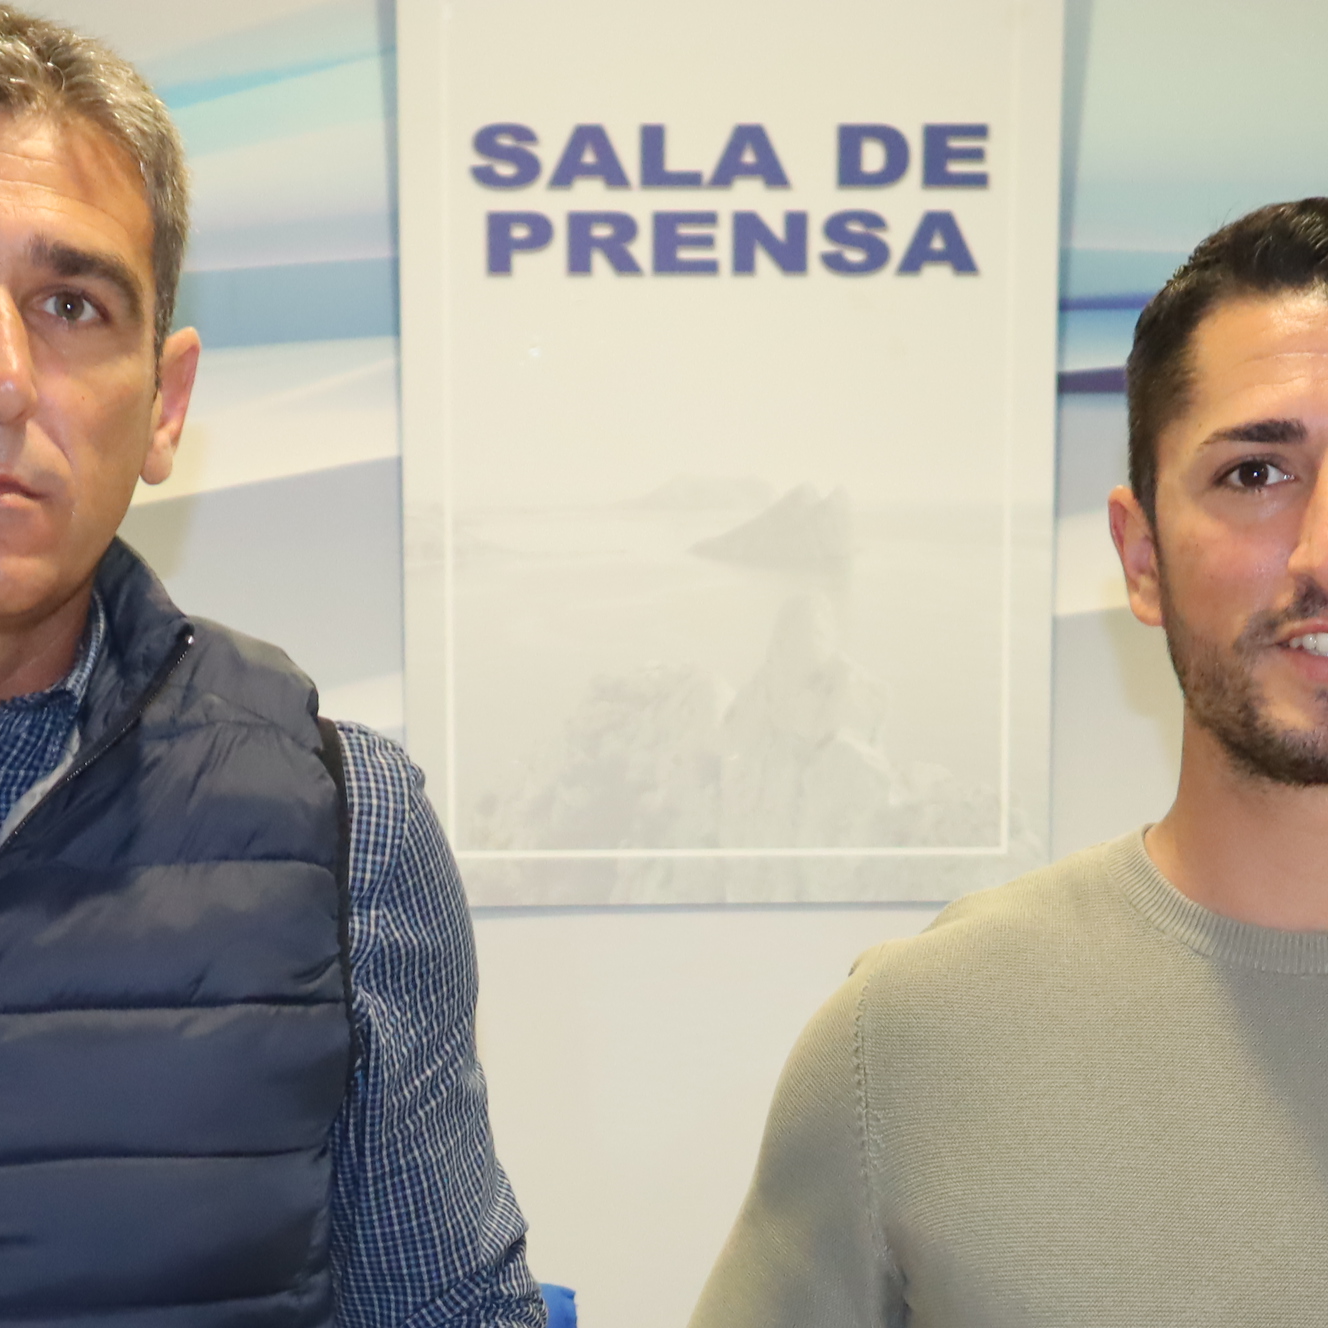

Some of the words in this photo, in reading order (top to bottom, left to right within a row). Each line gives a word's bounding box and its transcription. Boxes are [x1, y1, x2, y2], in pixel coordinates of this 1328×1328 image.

[469, 121, 792, 191] SALA
[834, 122, 990, 190] DE
[485, 209, 980, 277] PRENSA
